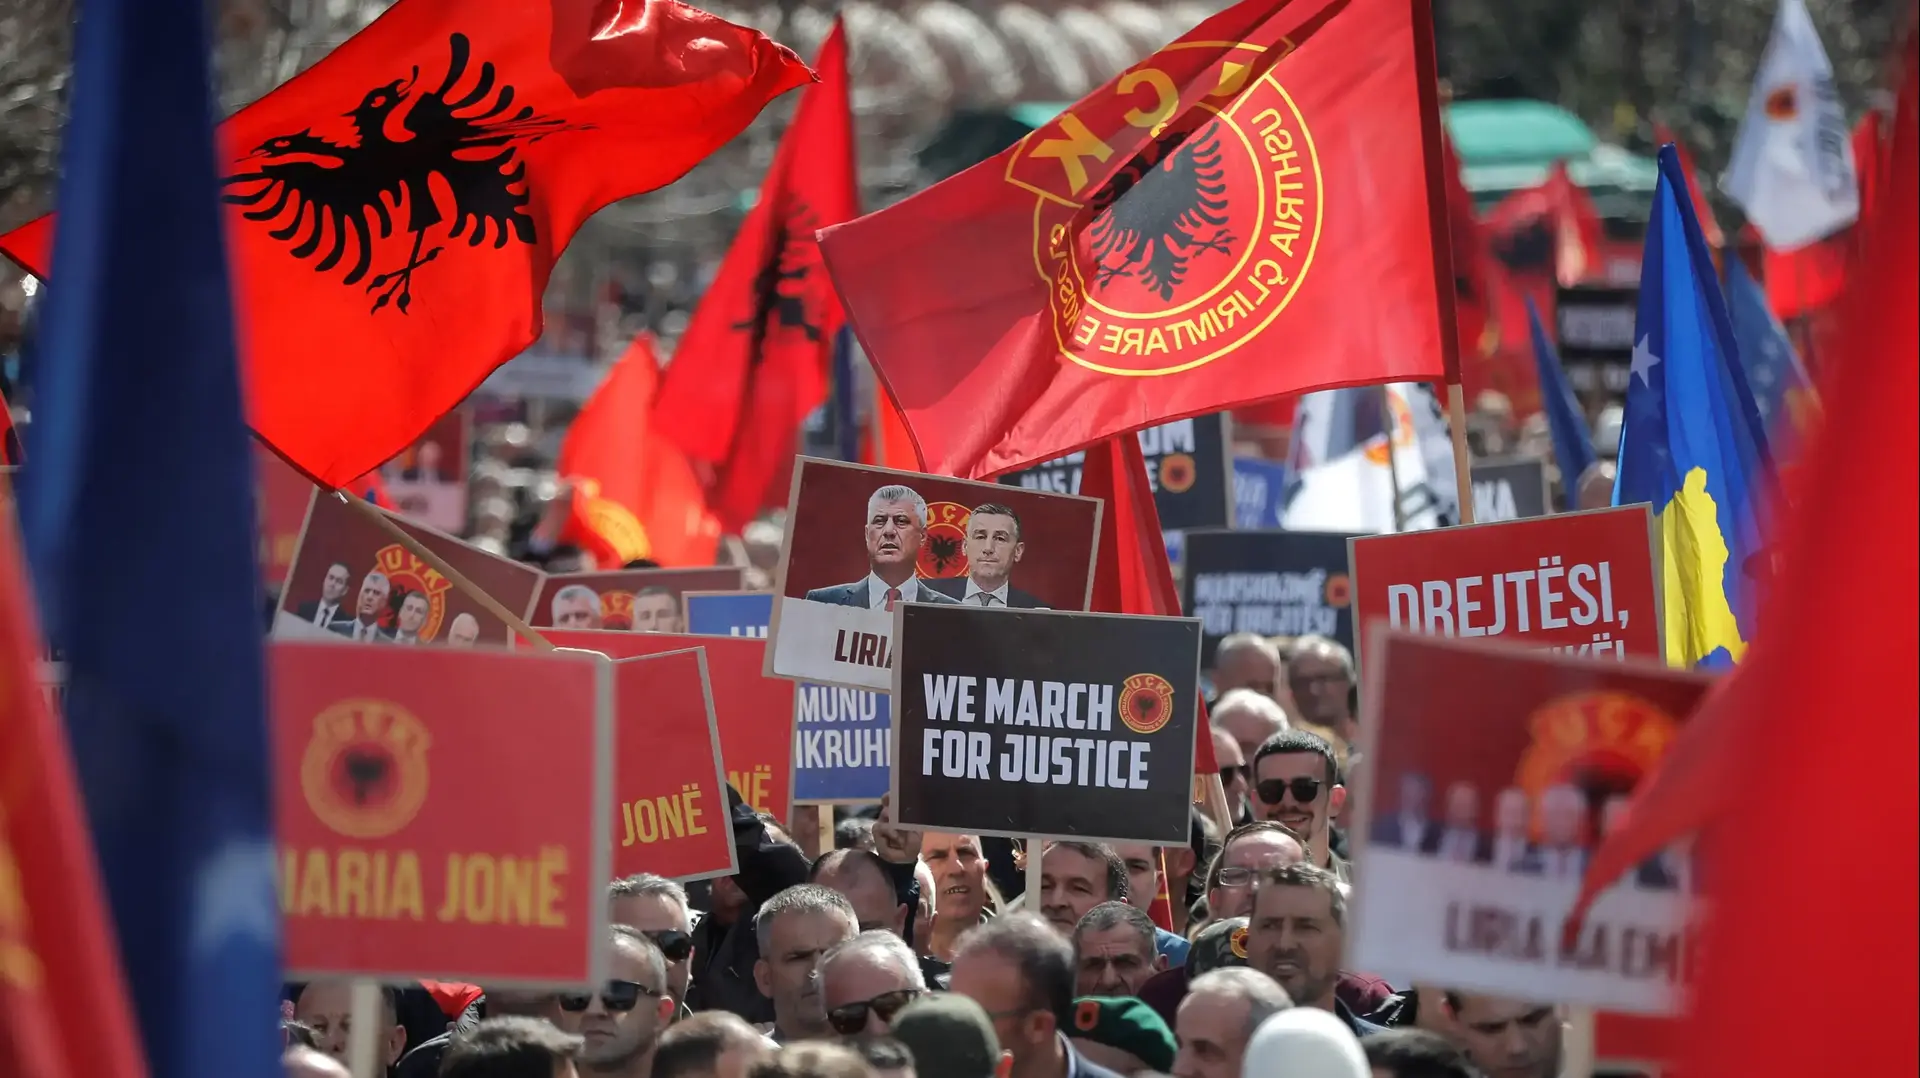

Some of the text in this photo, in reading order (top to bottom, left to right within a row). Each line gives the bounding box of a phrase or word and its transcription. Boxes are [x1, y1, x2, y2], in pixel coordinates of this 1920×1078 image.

[1388, 555, 1629, 639] DREJTËSI,
[922, 673, 1113, 731] WE MARCH
[729, 764, 772, 813] NË
[922, 728, 1151, 790] FOR JUSTICE
[622, 783, 707, 847] JONË
